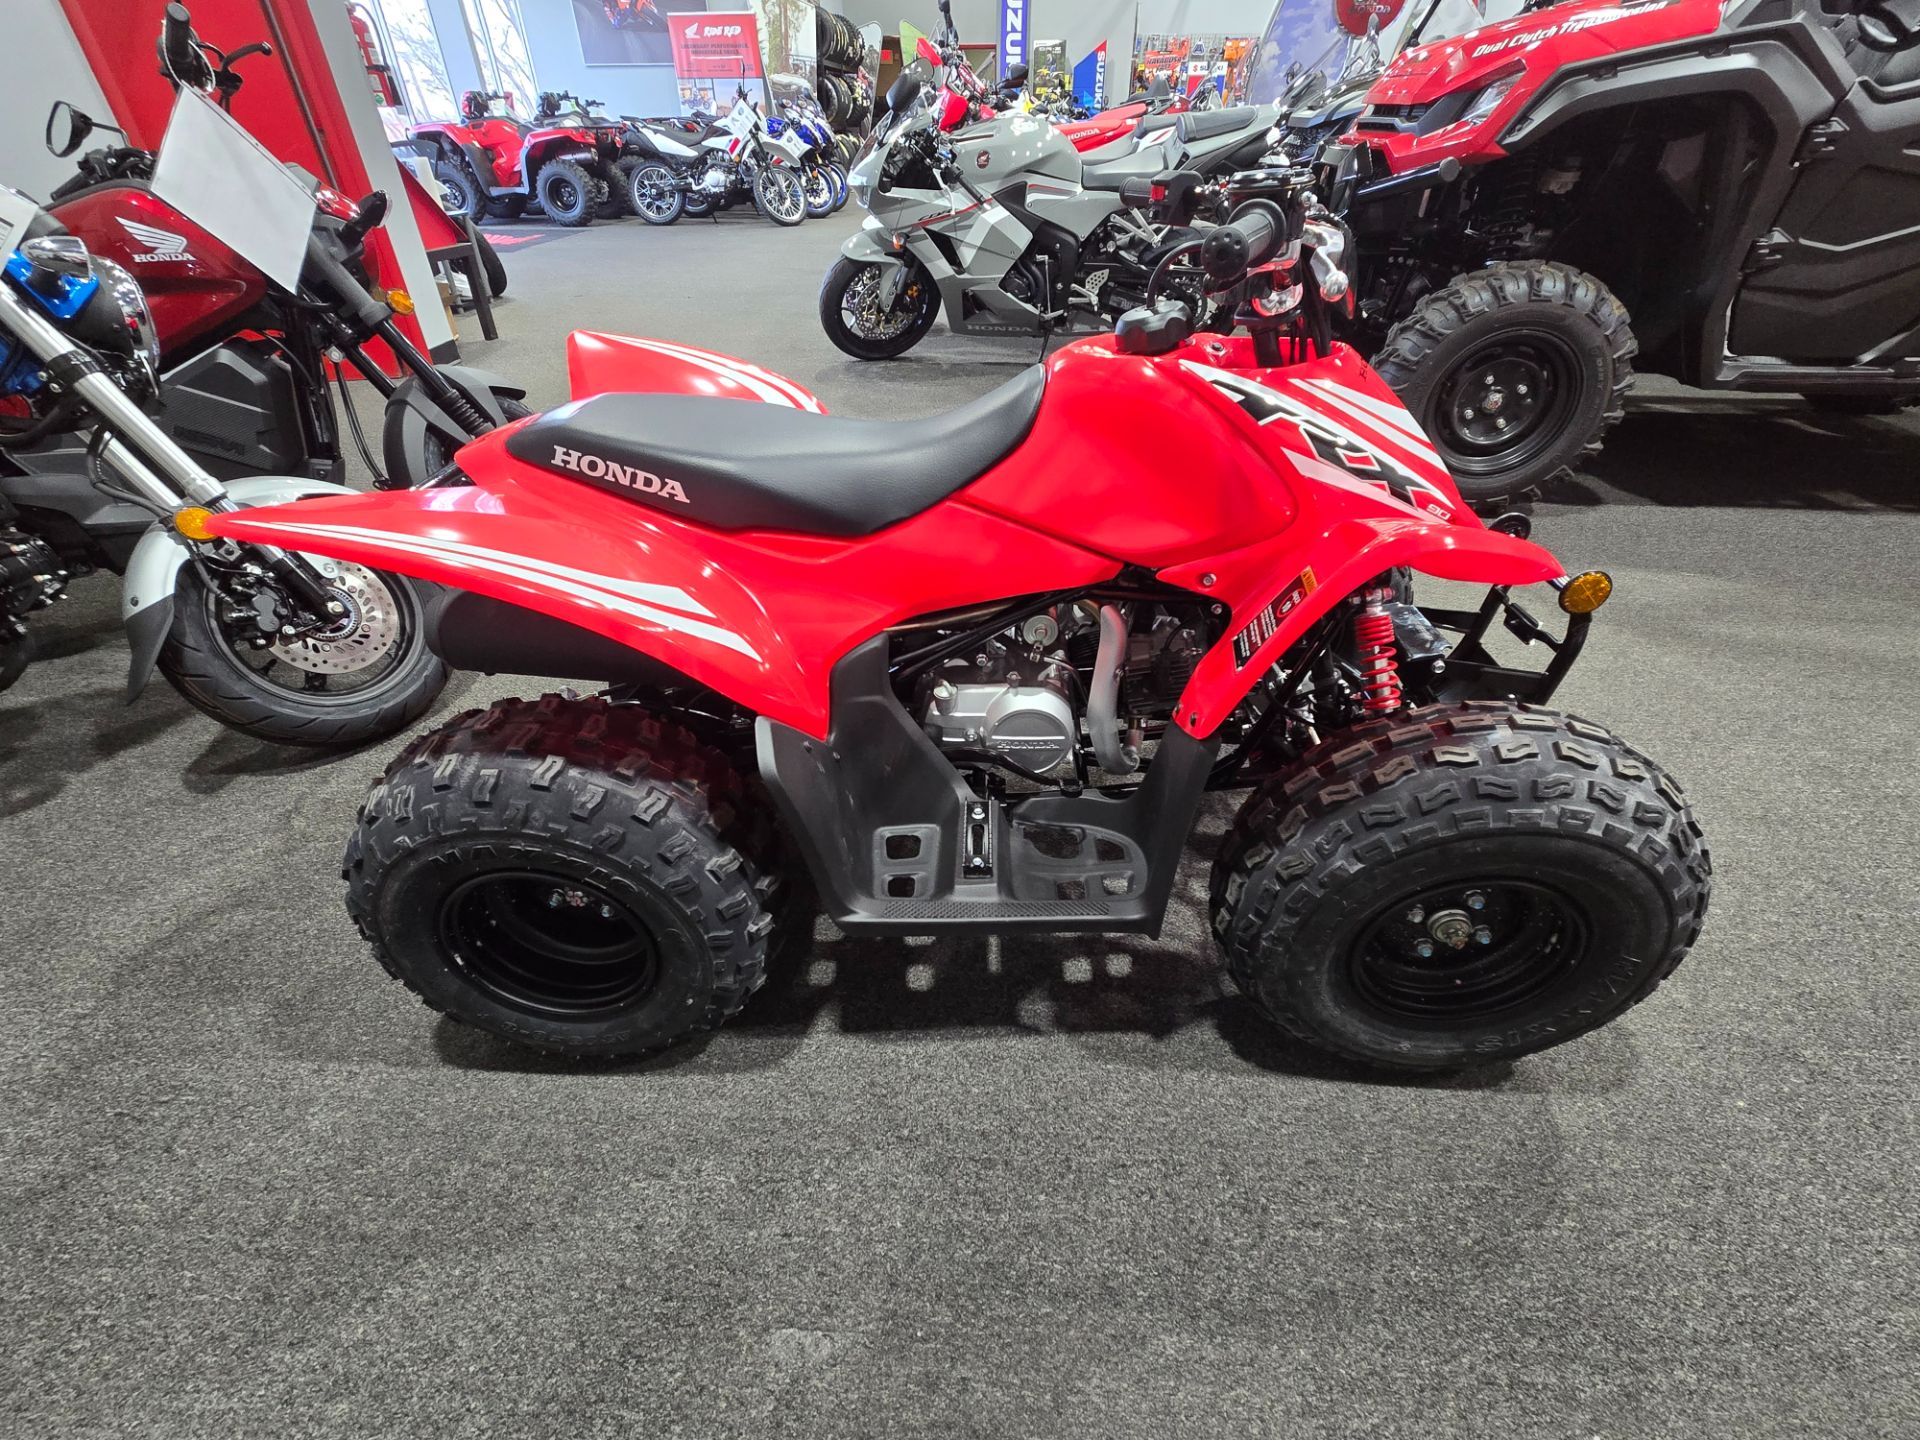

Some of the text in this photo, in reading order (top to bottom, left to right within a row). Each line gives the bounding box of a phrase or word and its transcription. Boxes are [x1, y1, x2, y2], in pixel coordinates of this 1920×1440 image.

[703, 25, 742, 37] RIDE RED
[1471, 38, 1506, 58] Dual
[1508, 25, 1559, 48] Clutch
[1199, 64, 1224, 72] SUKI
[1094, 50, 1106, 109] SUZUKI
[1067, 128, 1100, 140] HONDA
[132, 252, 196, 263] HONDA
[966, 324, 1034, 333] HONDA
[551, 445, 690, 503] HONDA
[996, 740, 1060, 750] HONDA
